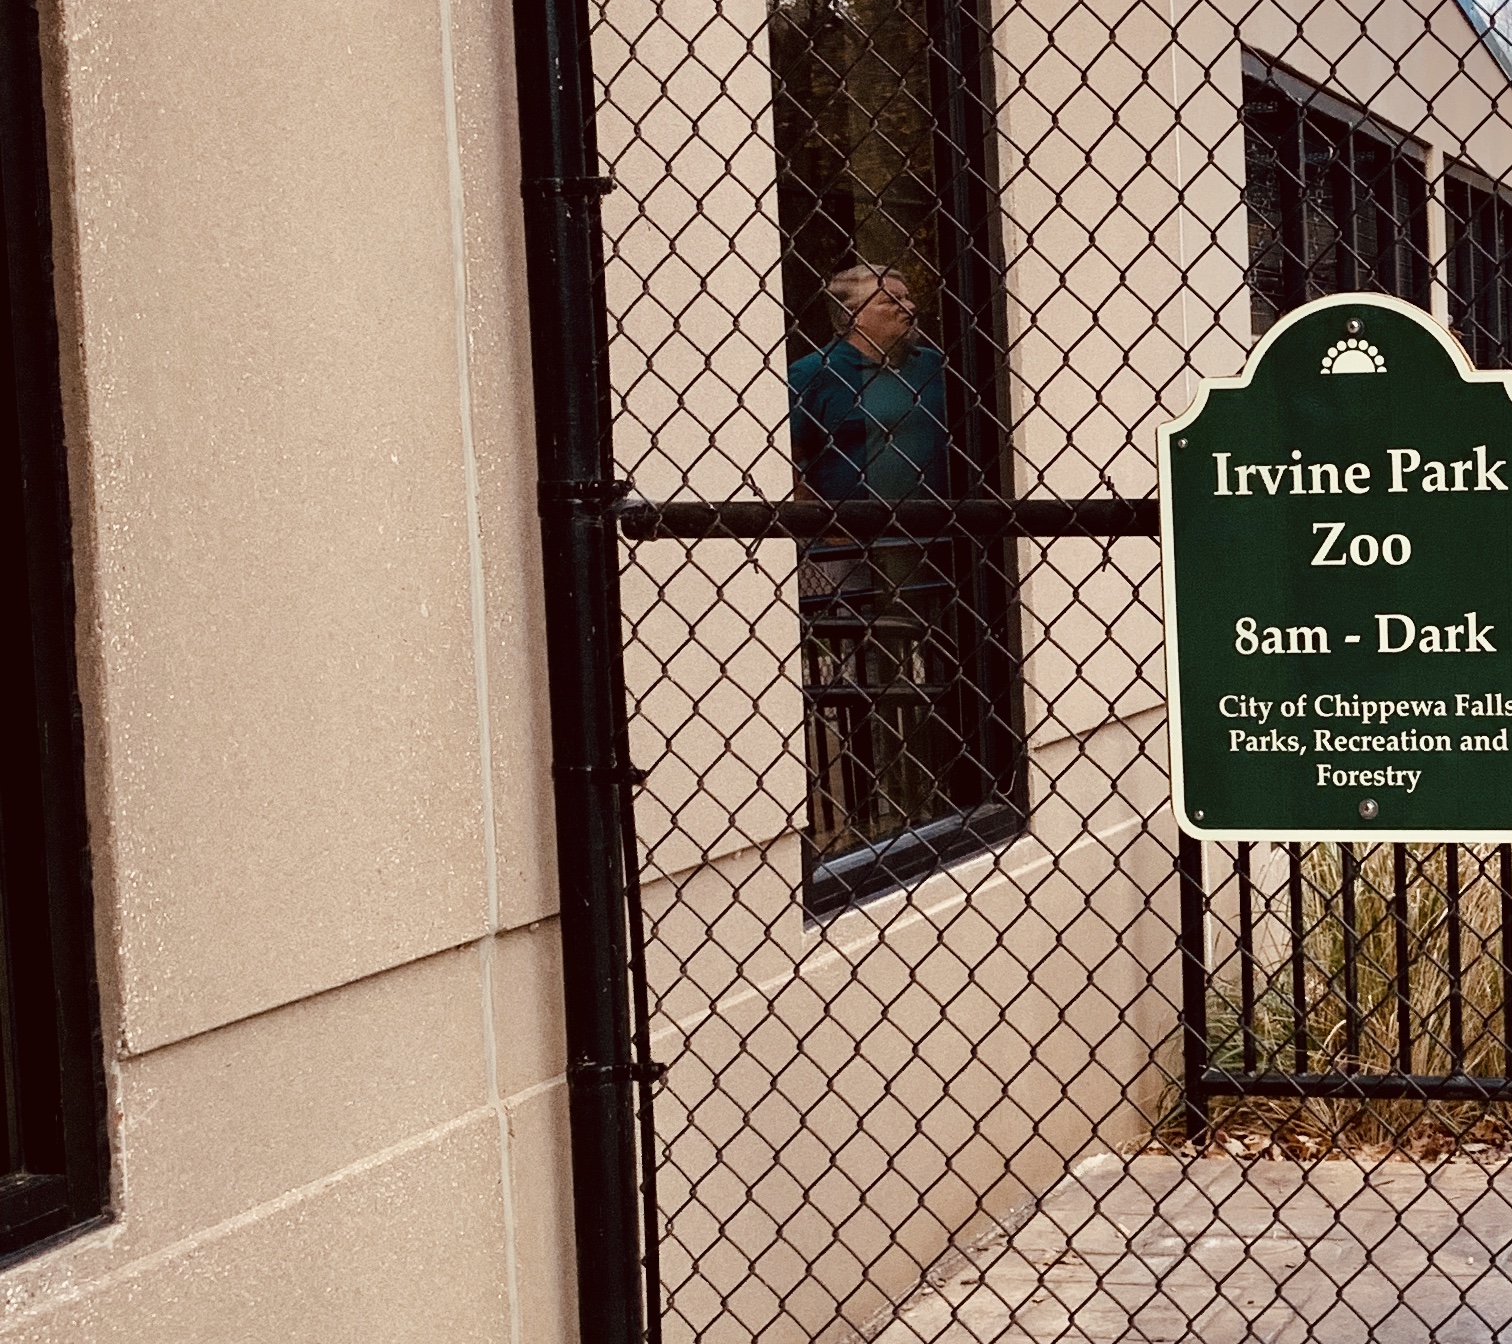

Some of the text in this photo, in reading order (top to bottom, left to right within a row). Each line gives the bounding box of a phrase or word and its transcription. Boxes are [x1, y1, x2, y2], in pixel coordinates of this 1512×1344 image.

[1211, 444, 1509, 496] Irvine Park
[1310, 522, 1412, 566] Zoo
[1235, 611, 1498, 655] 8am - Dark
[1219, 694, 1274, 725] City
[1280, 693, 1308, 718] of
[1314, 693, 1448, 725] Chippewa
[1228, 727, 1509, 756] Parks, Recreation and
[1316, 763, 1422, 794] Forestry
